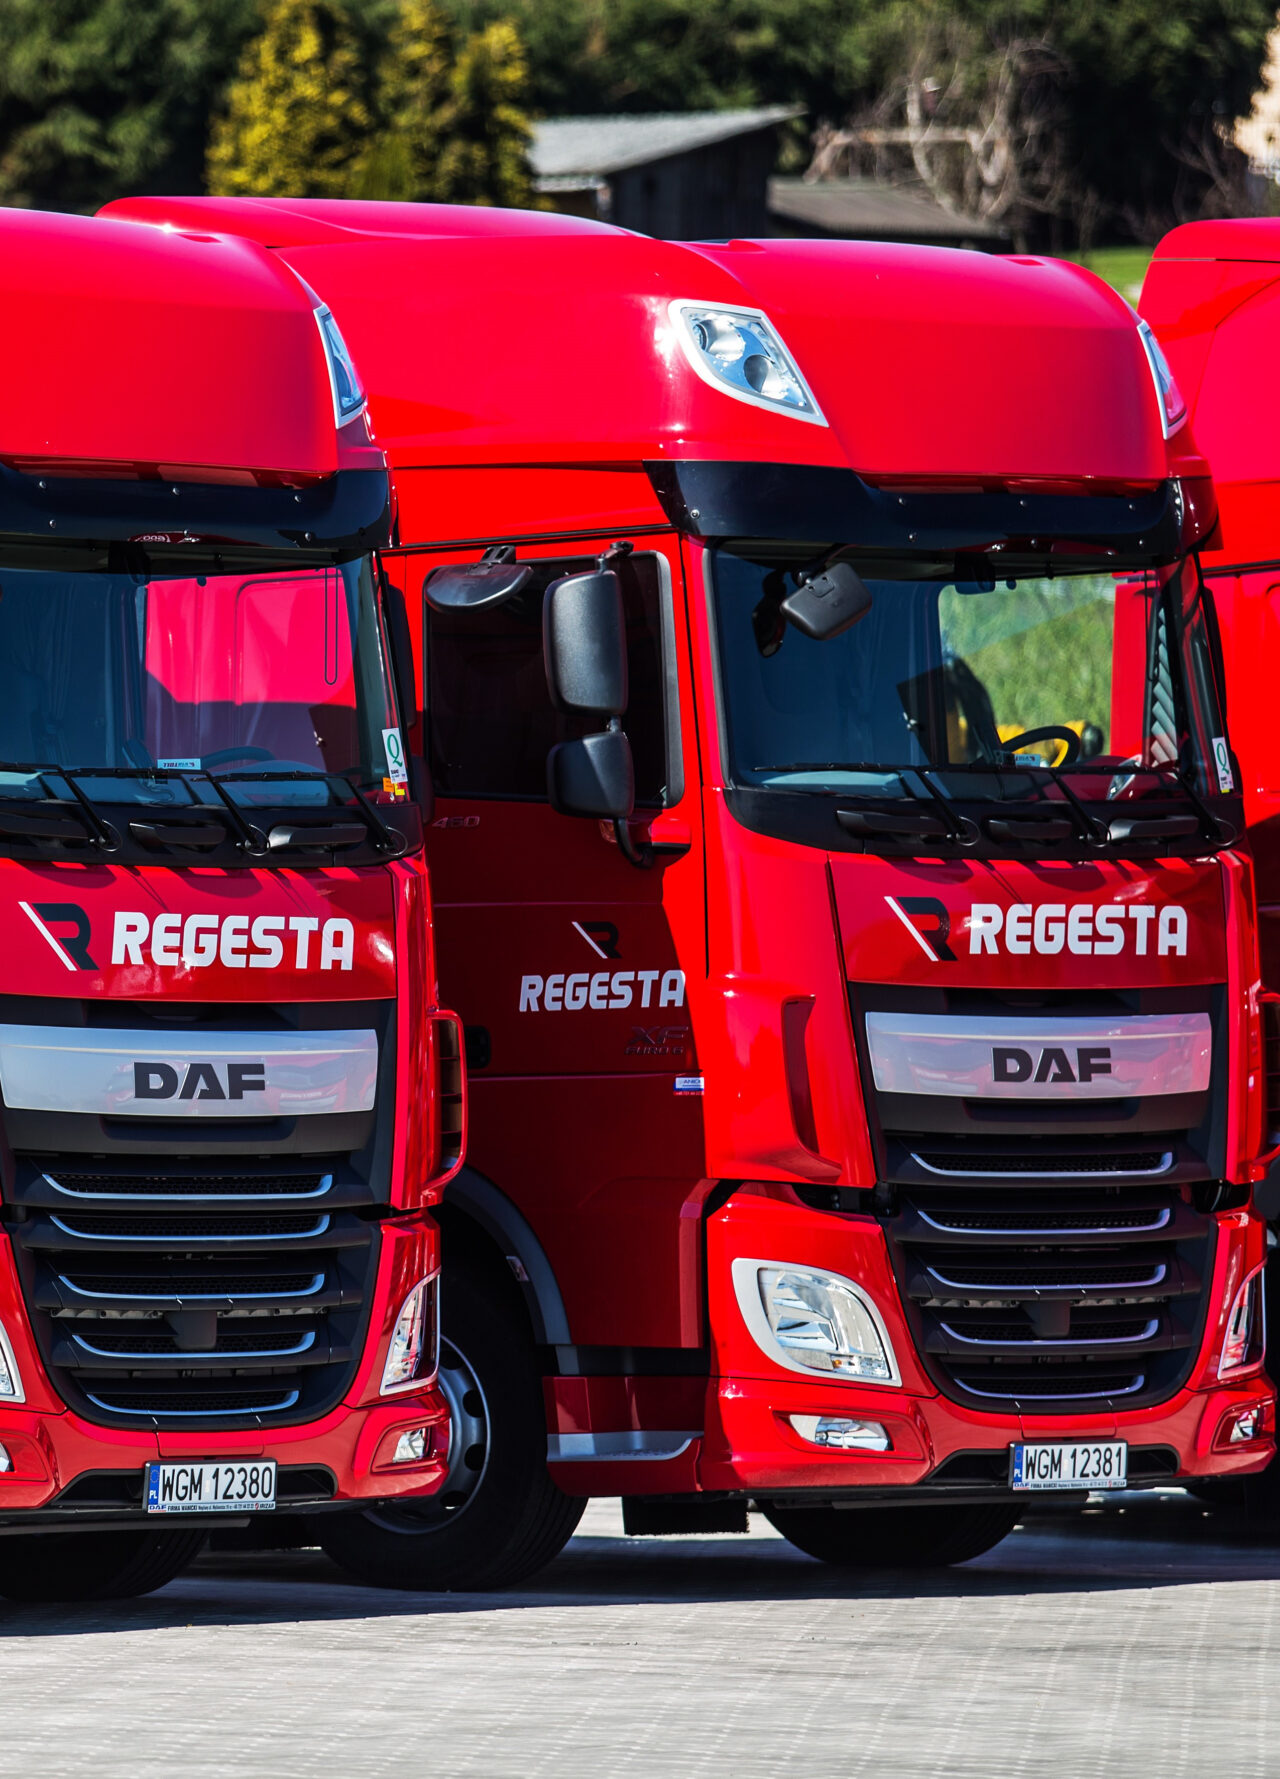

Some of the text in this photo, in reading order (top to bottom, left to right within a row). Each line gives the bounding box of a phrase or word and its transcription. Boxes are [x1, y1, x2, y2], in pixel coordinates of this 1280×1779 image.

[387, 733, 403, 768] Q
[1216, 742, 1229, 775] Q
[111, 911, 355, 971] REGESTA
[969, 903, 1188, 956] REGESTA
[519, 969, 687, 1012] REGESTA
[133, 1061, 266, 1100] DAF
[991, 1047, 1112, 1083] DAF
[1025, 1446, 1122, 1480] WGM 12381
[149, 1490, 158, 1499] PL
[162, 1466, 273, 1502] WGM 12380
